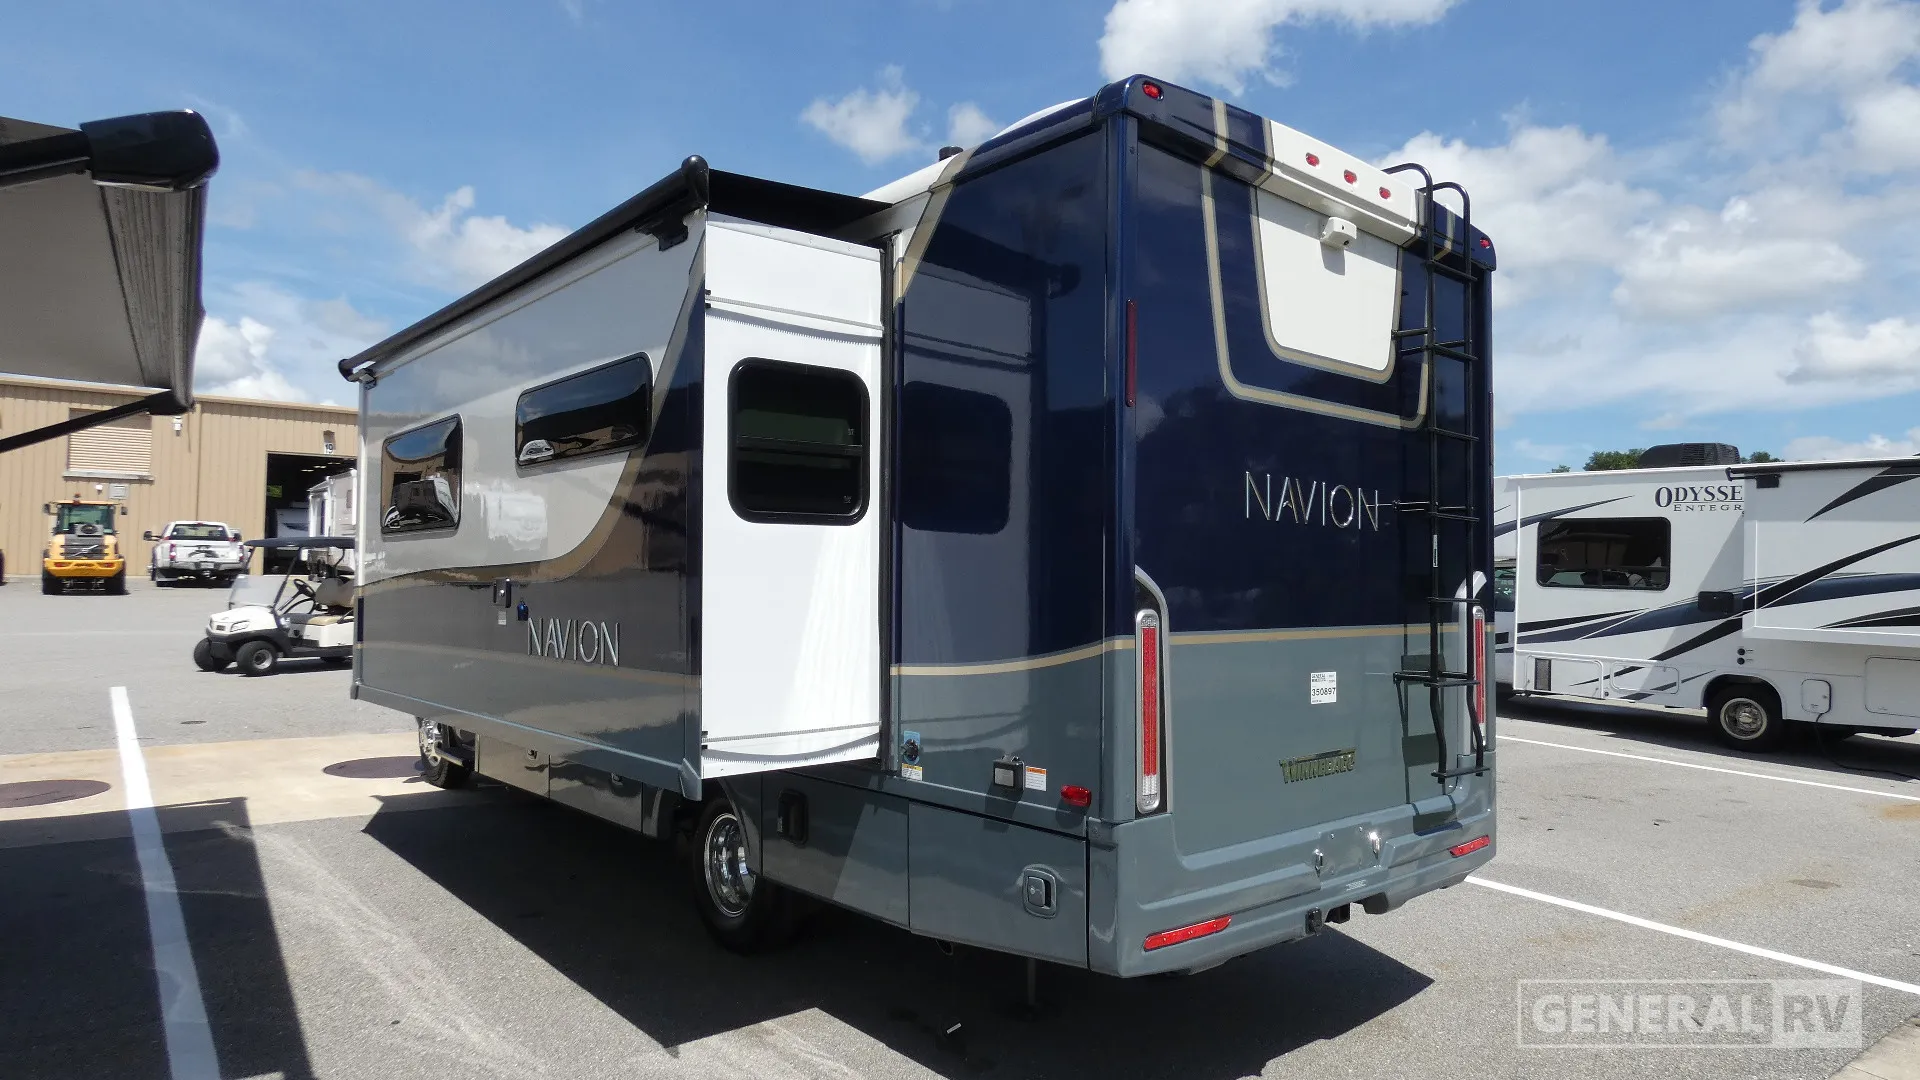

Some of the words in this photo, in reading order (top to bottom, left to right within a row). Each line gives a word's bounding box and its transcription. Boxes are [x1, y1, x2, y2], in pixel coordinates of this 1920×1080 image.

[1246, 471, 1379, 531] NAVION
[1655, 485, 1744, 508] ODYSSE
[1673, 504, 1743, 512] ENTEGR
[527, 617, 620, 666] NAVION
[1311, 687, 1336, 697] 350897
